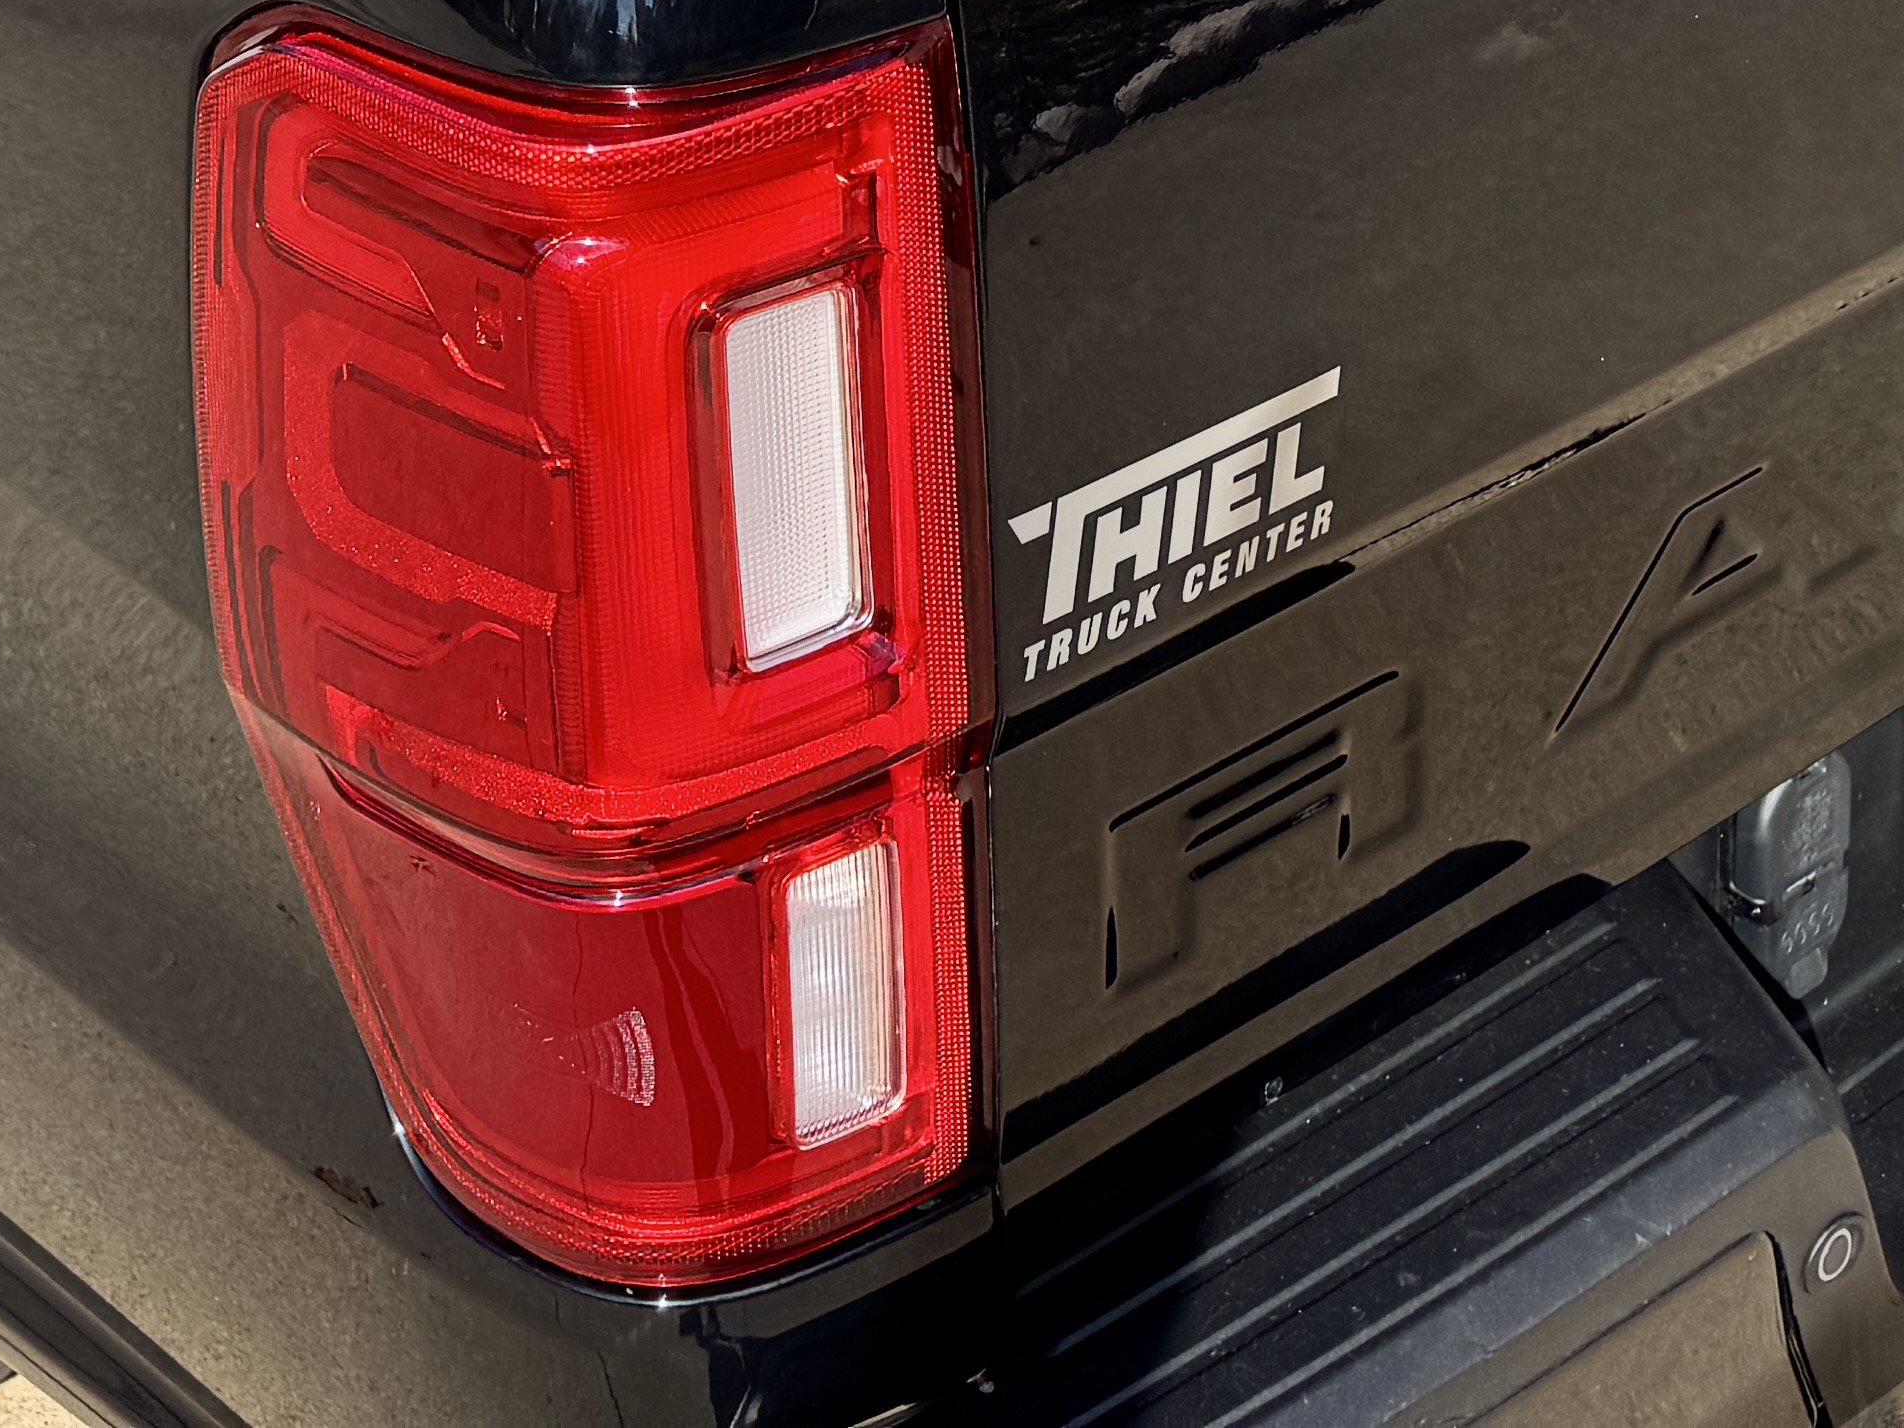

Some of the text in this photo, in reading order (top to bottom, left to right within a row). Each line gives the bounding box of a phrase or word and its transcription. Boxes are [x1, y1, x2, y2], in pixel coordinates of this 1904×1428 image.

[1007, 364, 1342, 626] THIEL
[1023, 500, 1335, 683] TRUCK CENTER
